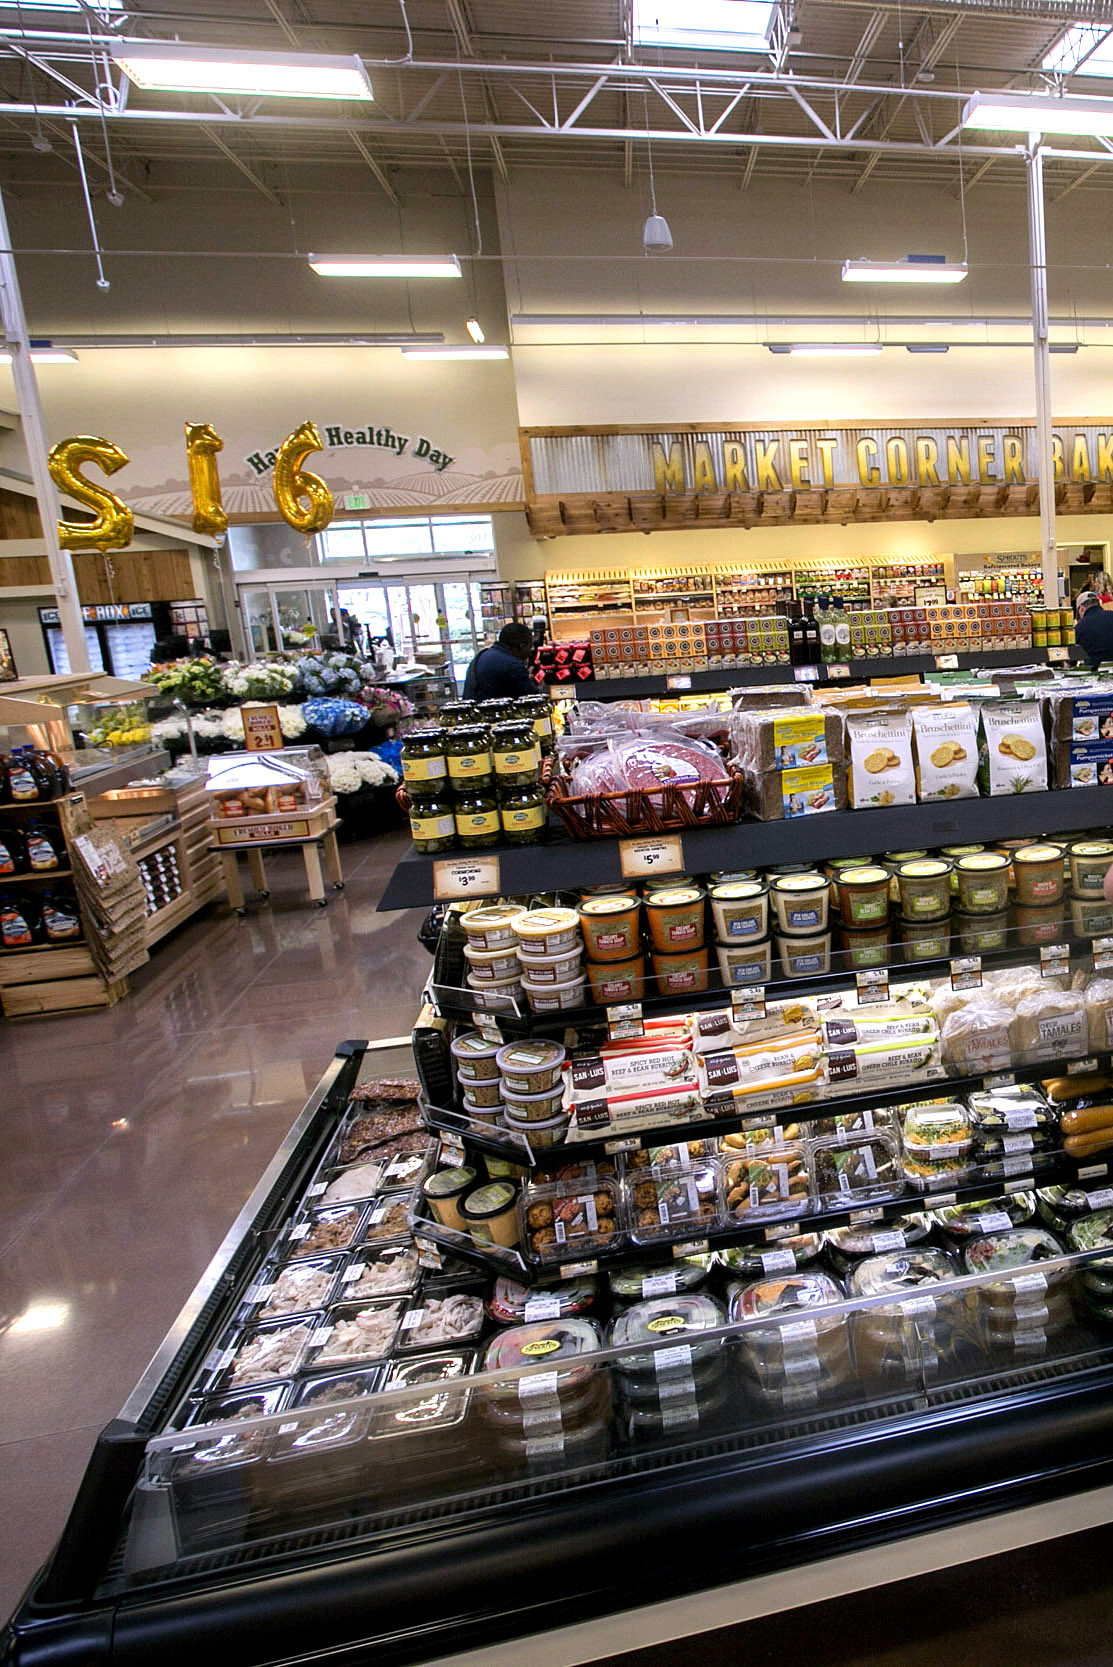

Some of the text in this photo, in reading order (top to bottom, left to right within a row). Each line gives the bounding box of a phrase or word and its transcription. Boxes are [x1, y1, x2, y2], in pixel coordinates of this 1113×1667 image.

[325, 426, 410, 455] Healthy
[414, 437, 456, 472] Day
[652, 437, 838, 495] MARKET
[855, 433, 1029, 490] CORNER
[132, 605, 149, 616] ICE
[988, 715, 1040, 727] Bruschettini
[920, 722, 973, 734] Bruschettini
[255, 736, 263, 748] 2
[700, 1017, 728, 1031] SAN LUIS
[827, 1028, 840, 1037] SAN
[1040, 1022, 1082, 1041] TAMALES
[967, 1036, 1009, 1052] TAMALES
[629, 1055, 675, 1067] SPICY RED HOT
[907, 1051, 922, 1059] BEAN
[611, 1067, 626, 1076] BEEF
[632, 1064, 650, 1073] BEAN
[650, 1060, 677, 1071] BURRITO
[707, 1065, 738, 1080] SAN LUIS
[828, 1062, 857, 1076] SAN LUIS
[861, 1063, 881, 1071] GREEN
[881, 1061, 898, 1069] CHILE
[573, 1066, 605, 1082] SAN LUIS
[634, 1098, 681, 1111] SPICY RED HOT
[720, 1104, 736, 1113] LUIS
[578, 1111, 609, 1125] SAN LUIS
[616, 1110, 631, 1118] BEEF
